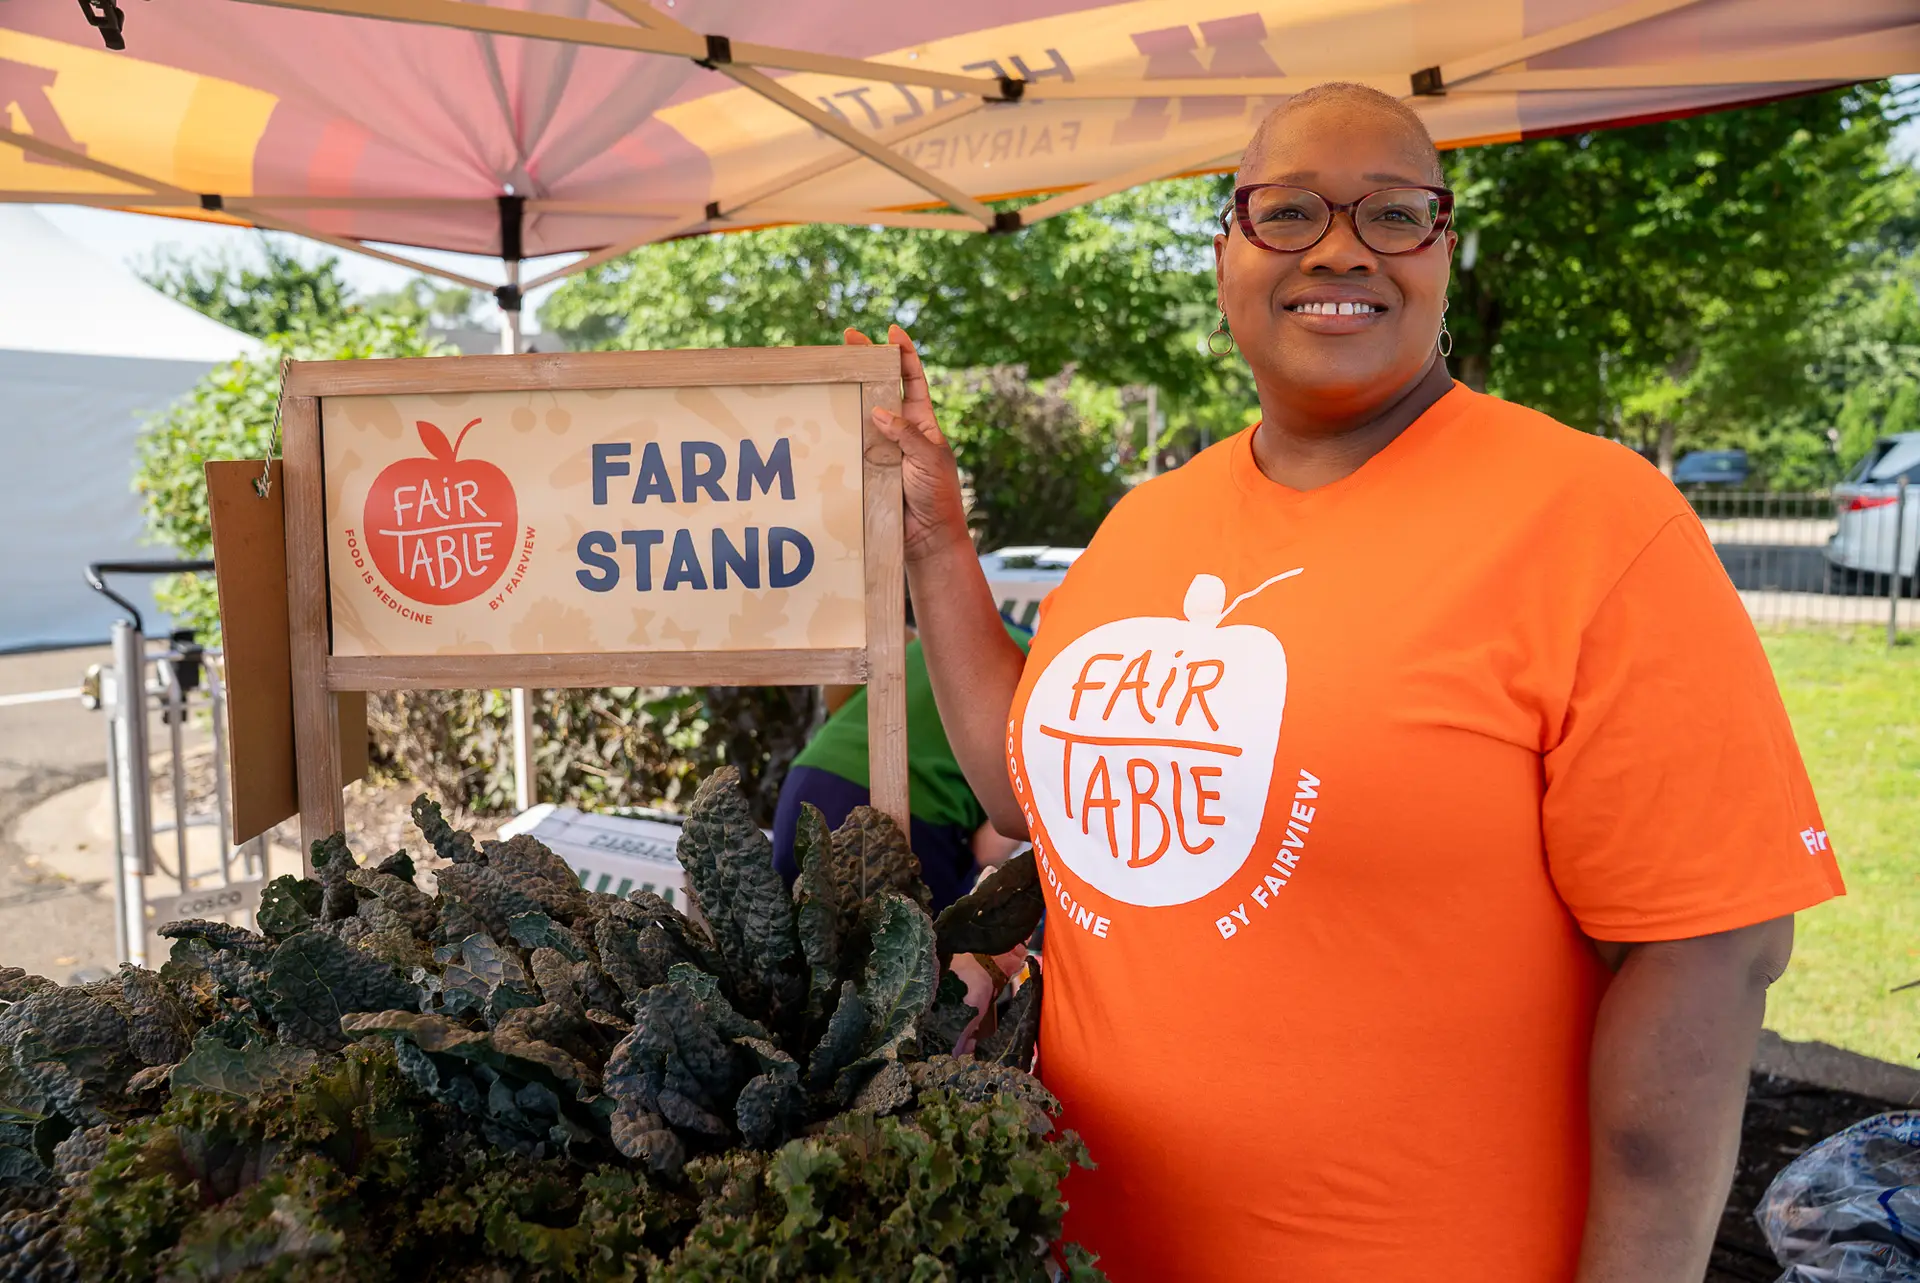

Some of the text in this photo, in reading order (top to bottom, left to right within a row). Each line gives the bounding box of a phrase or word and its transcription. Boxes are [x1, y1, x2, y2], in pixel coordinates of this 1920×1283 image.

[591, 437, 797, 506] FARM
[345, 528, 433, 625] FOOD IS MEDICINE
[379, 521, 503, 590] TABLE
[488, 525, 537, 611] BY FAIRVIEW
[575, 525, 816, 593] STAND
[1007, 719, 1112, 939] FOOD IS MEDICINE
[1040, 724, 1243, 869] TABLE
[1214, 767, 1323, 941] BY FAIRVIEW
